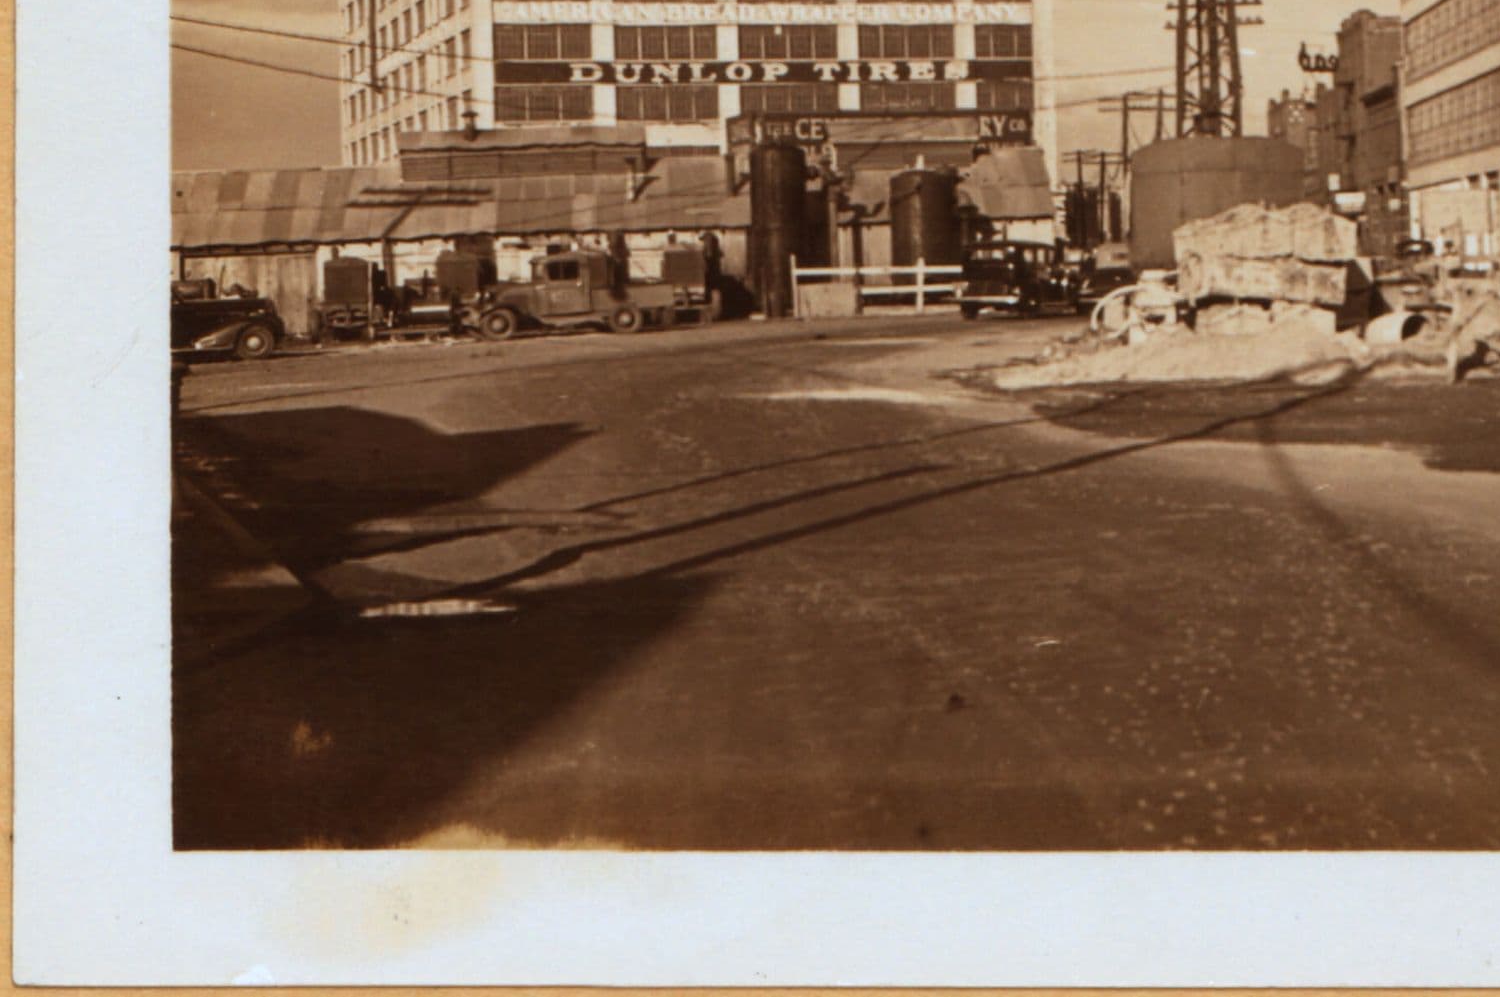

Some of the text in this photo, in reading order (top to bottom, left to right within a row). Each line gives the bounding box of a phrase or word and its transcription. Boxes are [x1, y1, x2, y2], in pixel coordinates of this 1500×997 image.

[513, 1, 652, 22] AMERICAN
[899, 3, 1017, 23] COMPANY
[568, 61, 970, 85] DUNLOP TIRES
